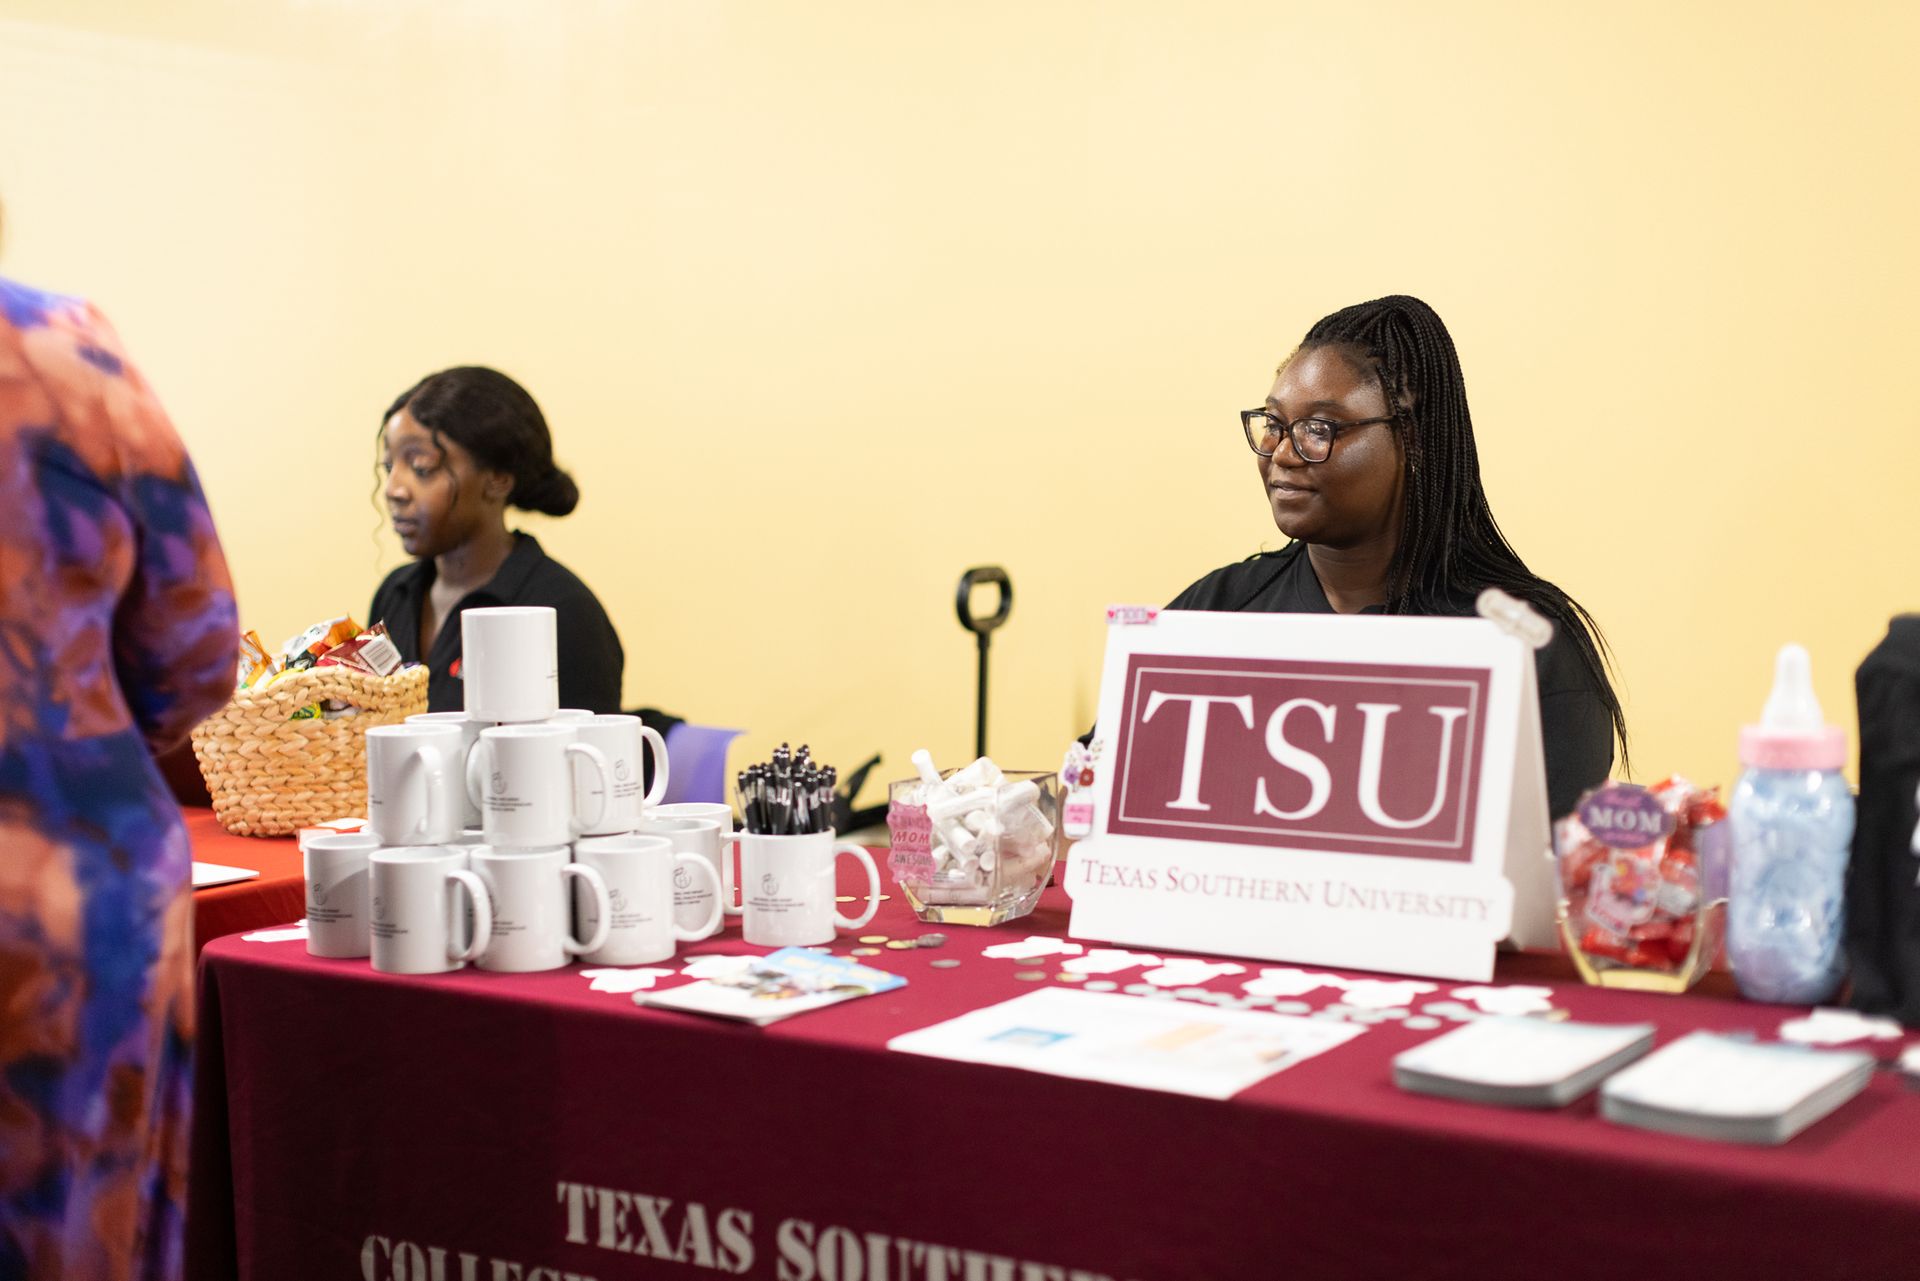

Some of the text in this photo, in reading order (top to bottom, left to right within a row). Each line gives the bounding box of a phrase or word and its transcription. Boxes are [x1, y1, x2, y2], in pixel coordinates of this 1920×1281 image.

[1142, 690, 1468, 829] TSU
[894, 831, 929, 844] MOM
[1588, 805, 1663, 834] MOM
[1081, 858, 1494, 921] TEXAS SOUTHERN UNIVERSITY
[360, 1234, 600, 1281] COLL
[557, 1180, 1125, 1281] TEXAS SOUT
